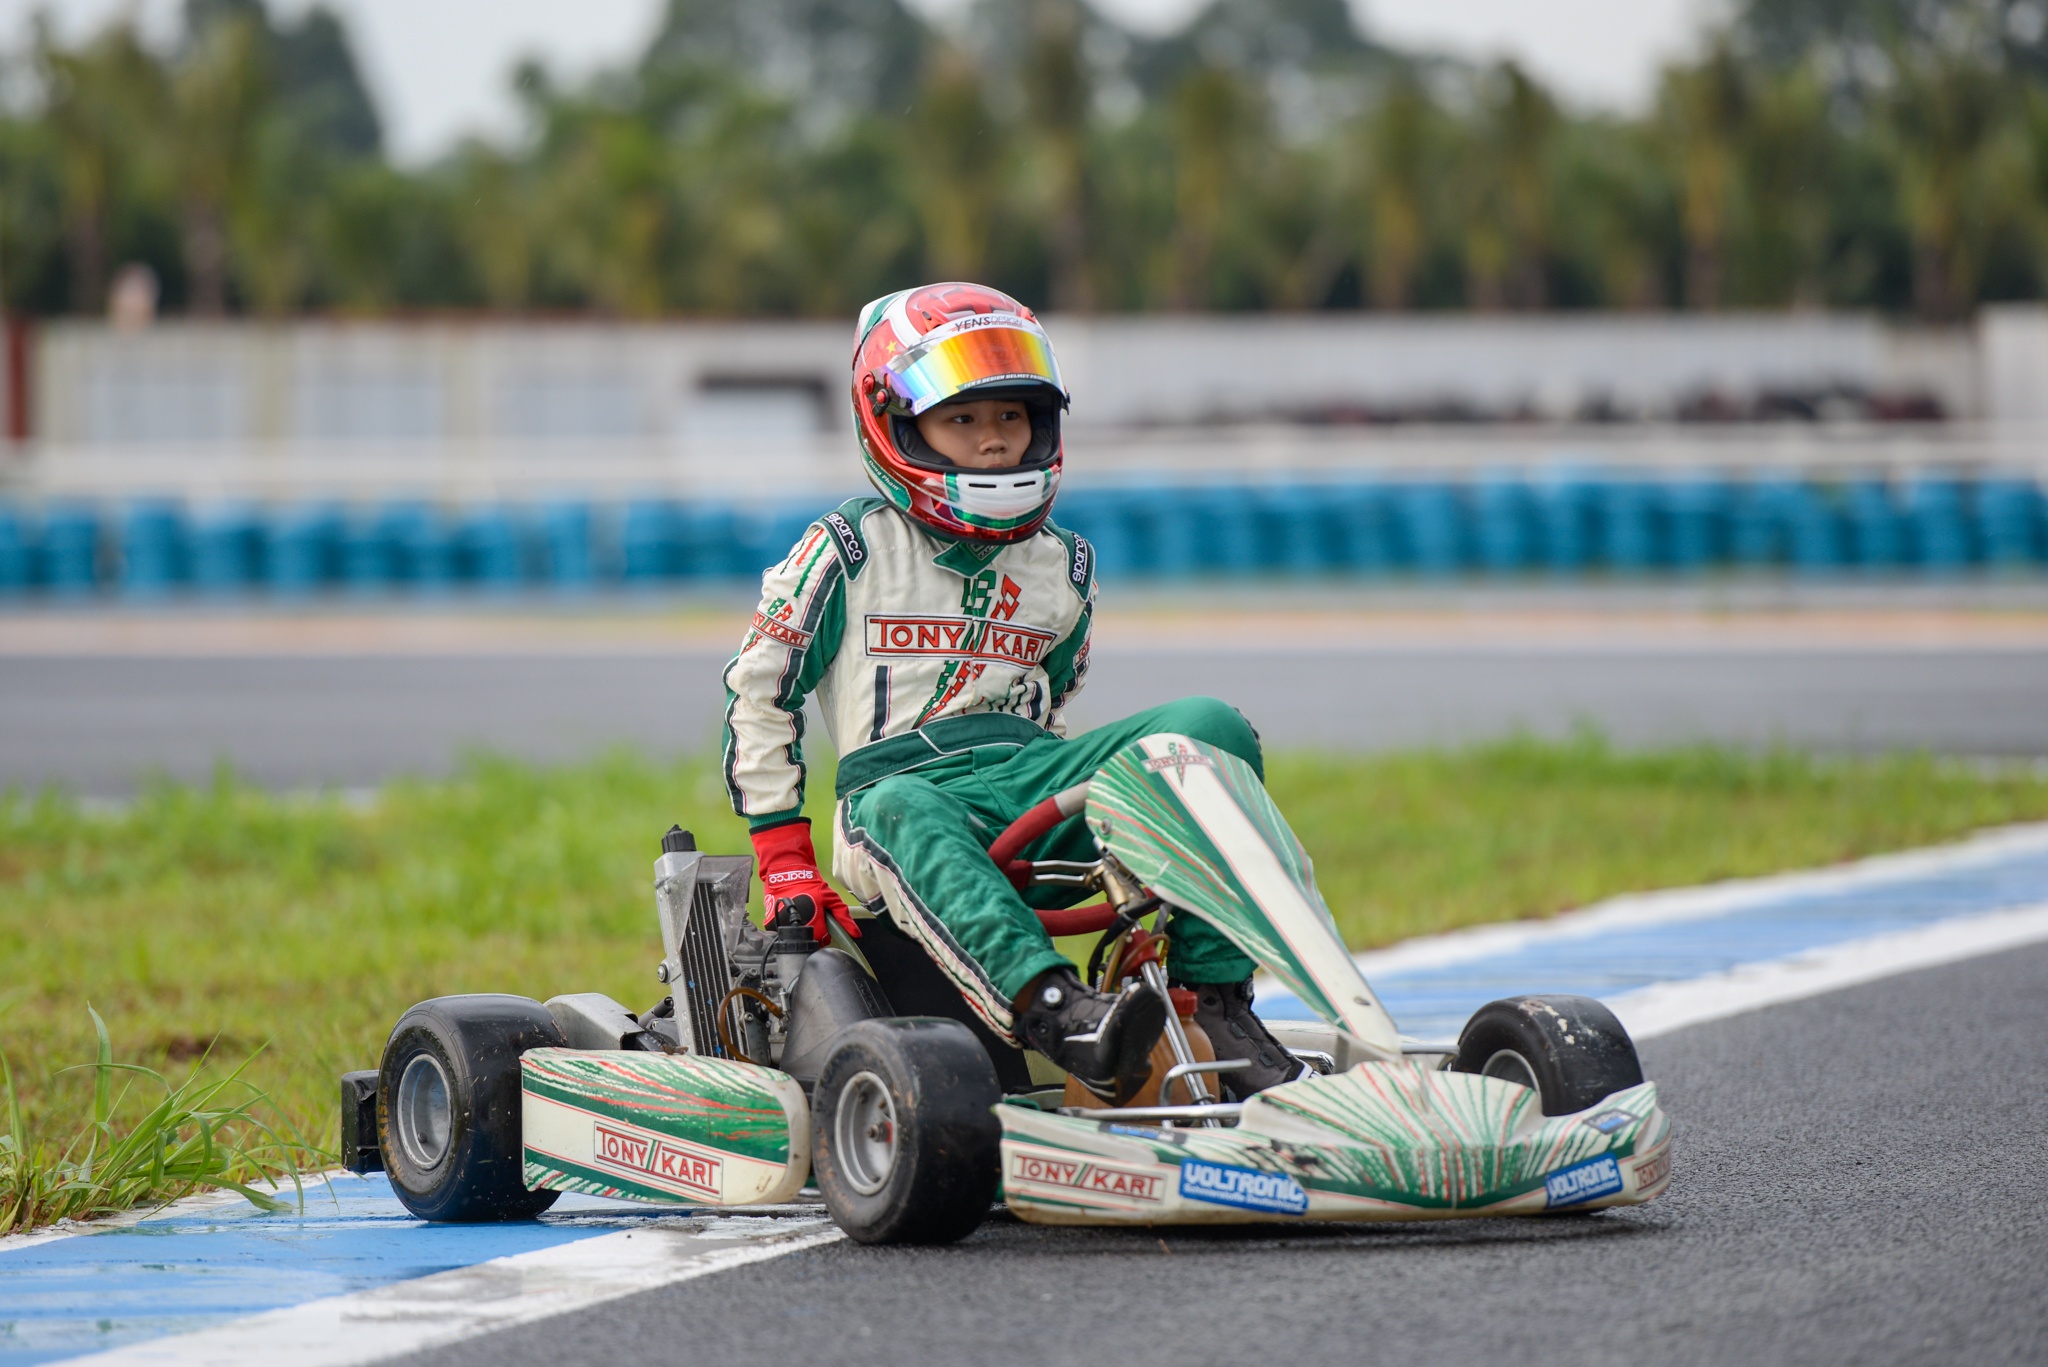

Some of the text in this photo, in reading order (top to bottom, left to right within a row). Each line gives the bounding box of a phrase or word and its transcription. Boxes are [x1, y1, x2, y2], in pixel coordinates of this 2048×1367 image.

[825, 513, 863, 563] sparco
[1072, 534, 1088, 585] sparco
[769, 621, 811, 647] KART
[870, 619, 1054, 661] TONY KART
[769, 869, 814, 884] sparco
[597, 1126, 721, 1187] TONY KART
[1015, 1154, 1163, 1197] TONY KART
[1183, 1162, 1306, 1202] VOLTRONIC
[1546, 1157, 1619, 1199] VOLTRONIC
